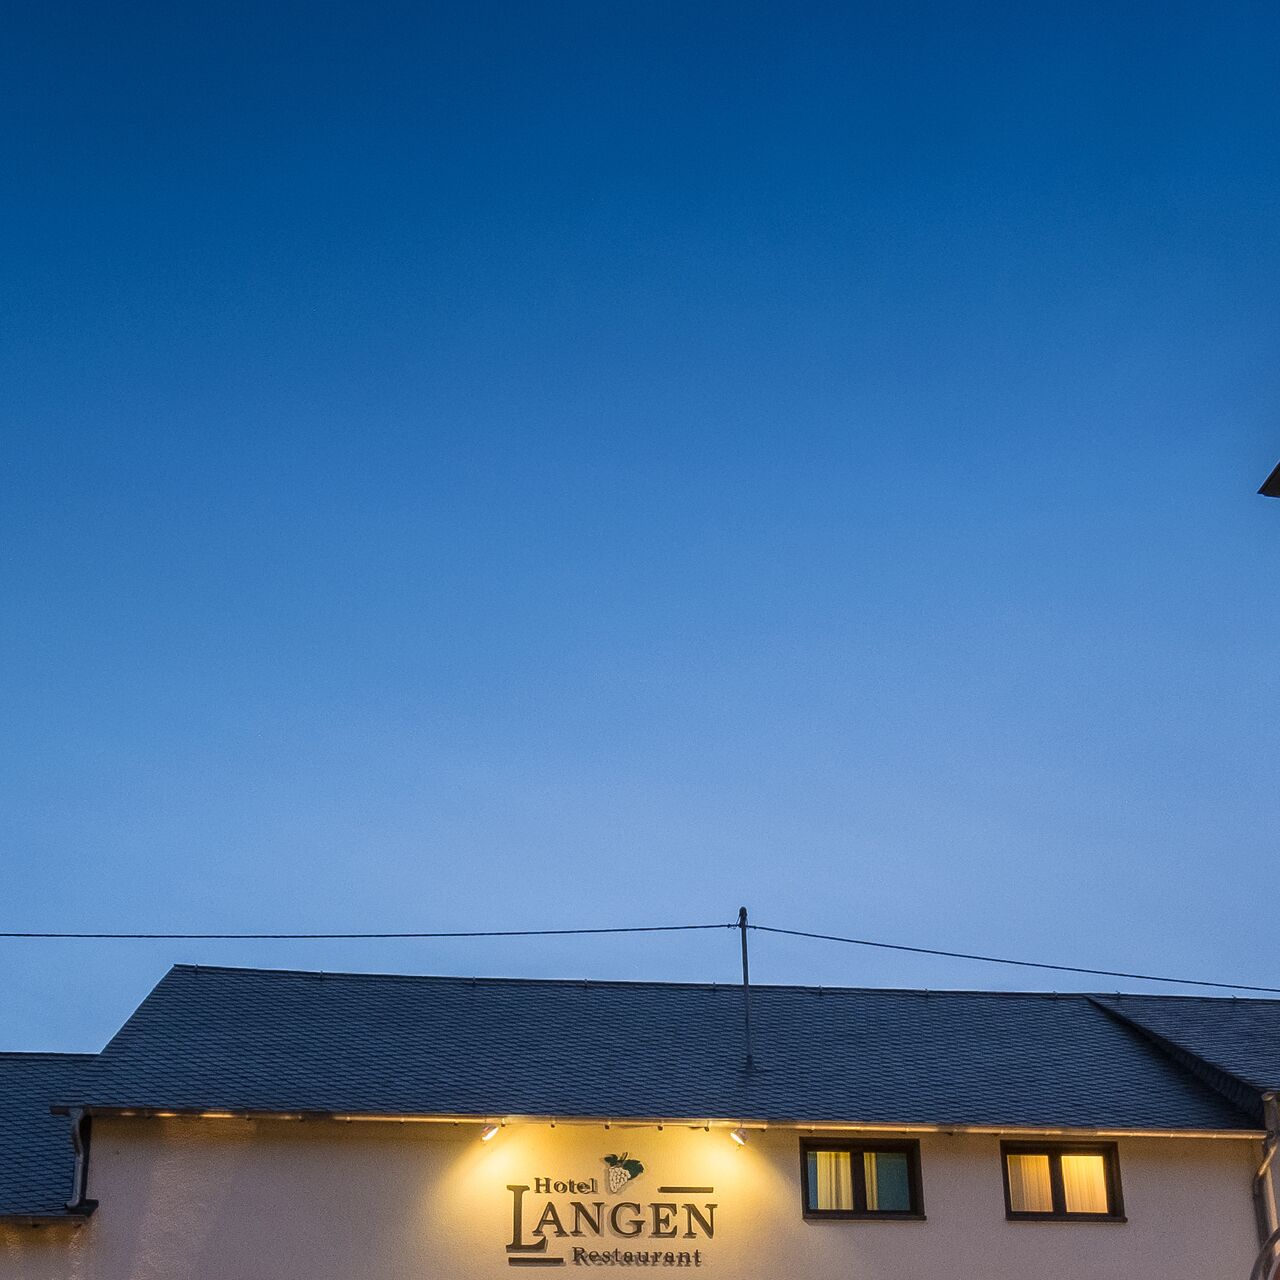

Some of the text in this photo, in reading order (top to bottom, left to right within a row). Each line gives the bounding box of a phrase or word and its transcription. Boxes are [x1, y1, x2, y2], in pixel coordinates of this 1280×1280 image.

[534, 1177, 597, 1194] Hotel
[506, 1184, 718, 1252] LANGEN
[572, 1246, 702, 1265] Restaurant
